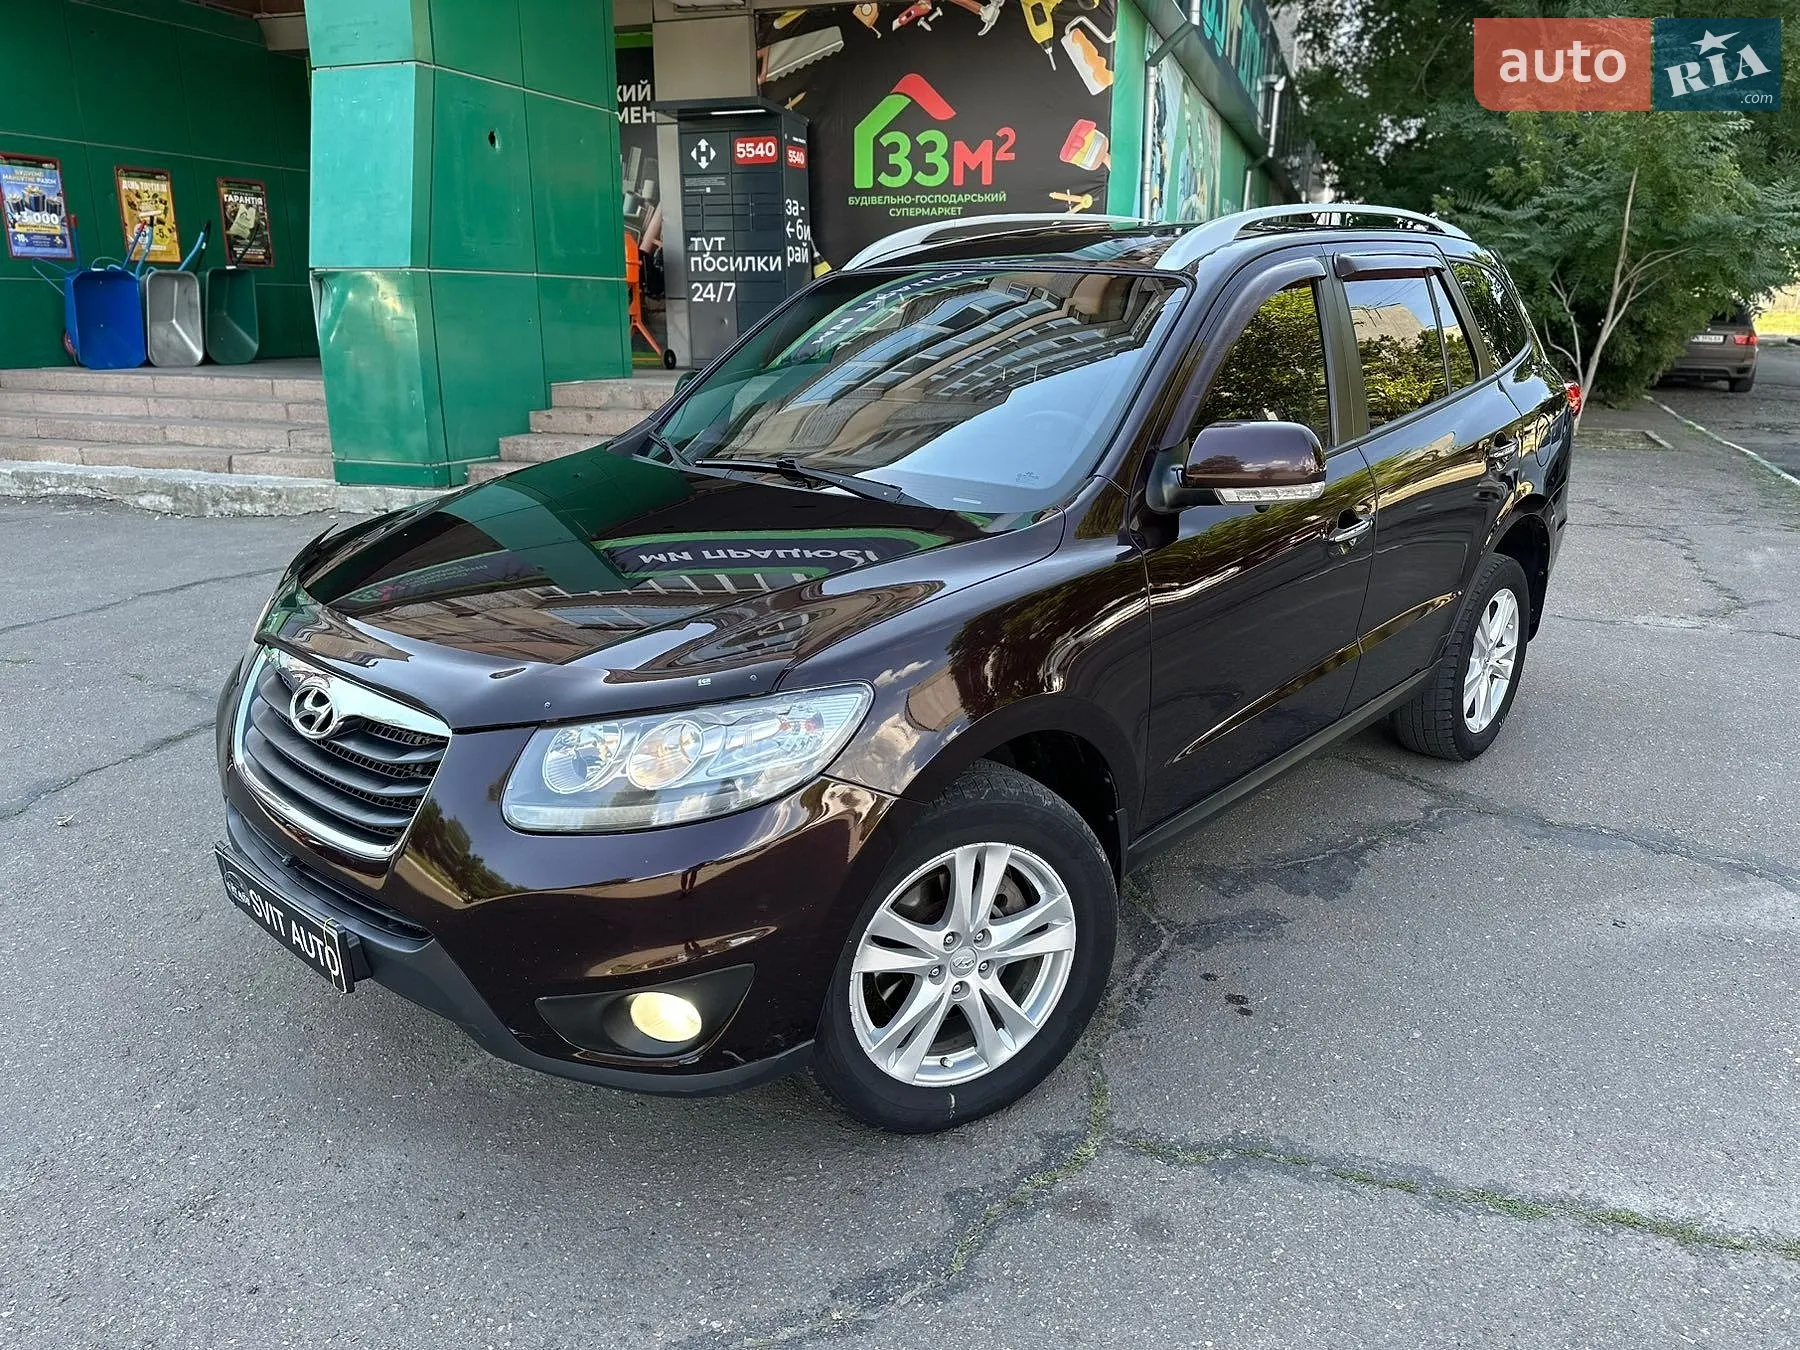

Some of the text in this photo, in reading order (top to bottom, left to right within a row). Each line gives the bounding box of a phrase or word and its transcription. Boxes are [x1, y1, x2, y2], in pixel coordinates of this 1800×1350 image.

[736, 141, 776, 159] 5540
[787, 149, 805, 165] 5540
[223, 193, 264, 206] ГАРАНТІЯ
[848, 190, 1007, 206] БУДІВЕЛЬНО-ГОСПОДАРСЬКИЙ
[889, 206, 963, 217] СУПЕРМАРКЕТ
[691, 282, 736, 302] 24/7
[249, 888, 286, 937] SVIT
[291, 919, 340, 977] AUTO
